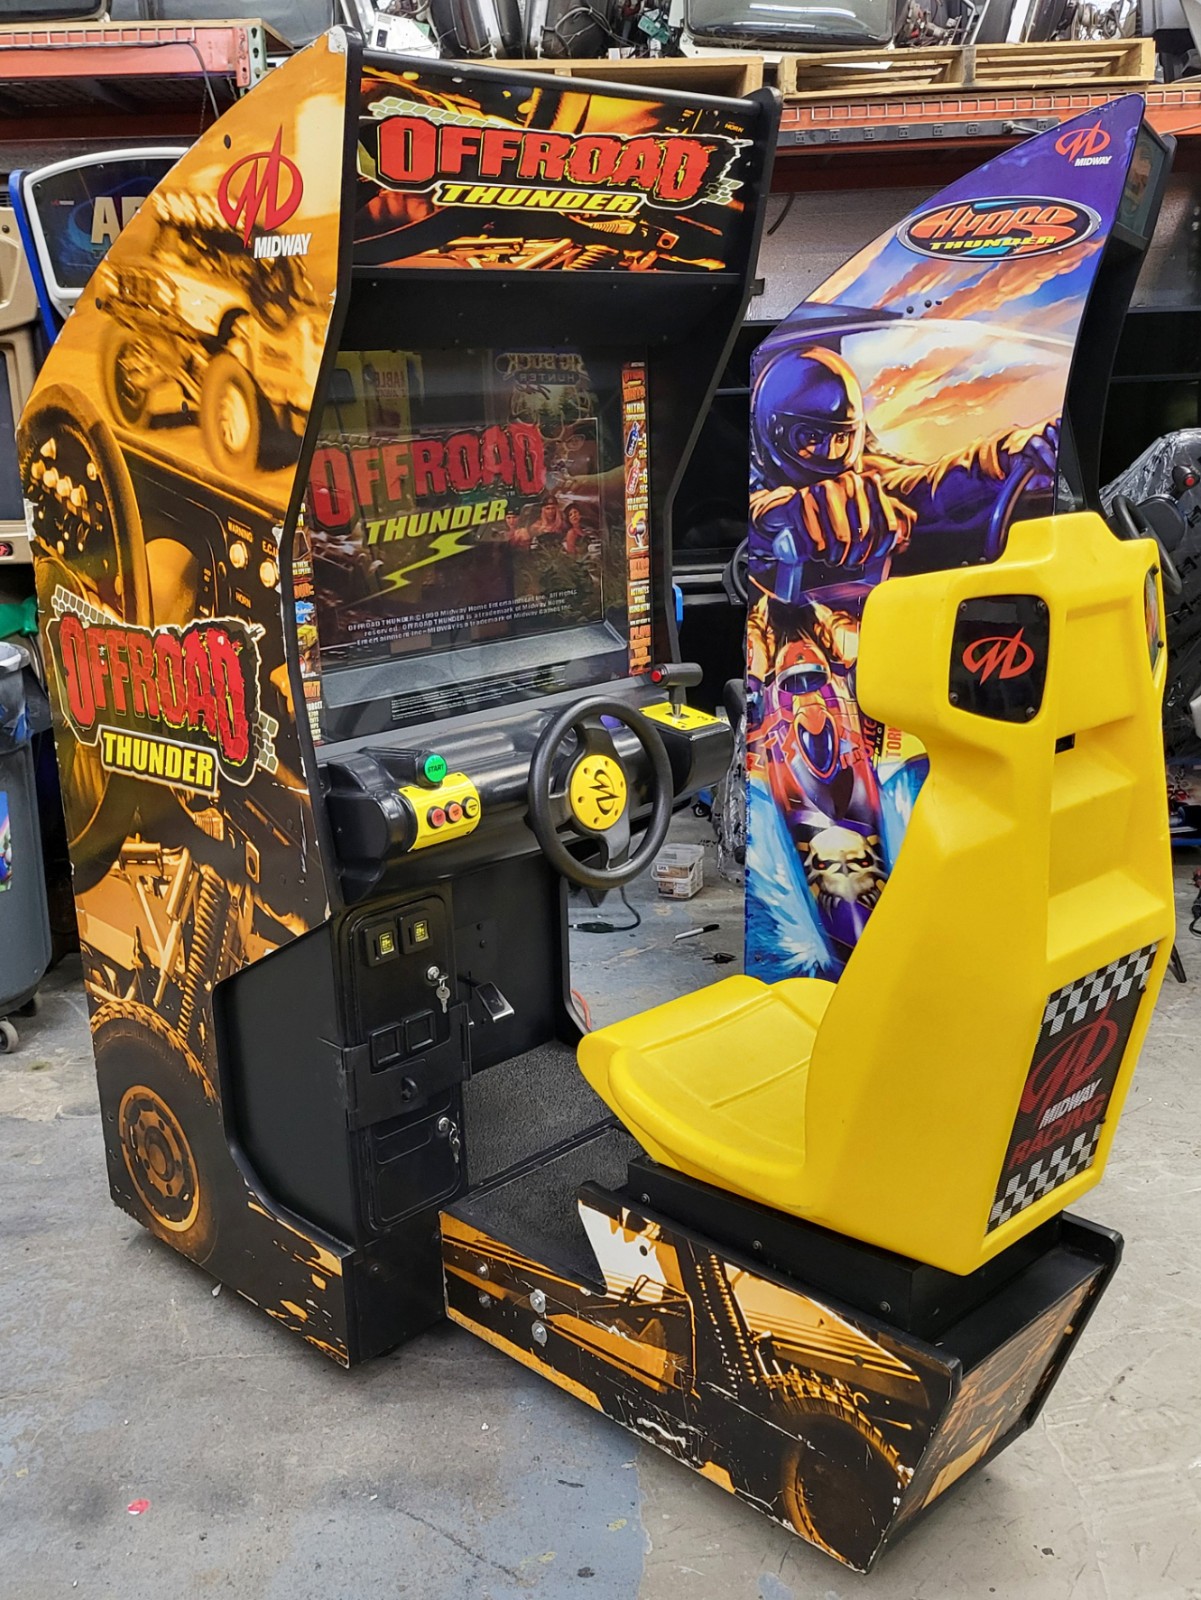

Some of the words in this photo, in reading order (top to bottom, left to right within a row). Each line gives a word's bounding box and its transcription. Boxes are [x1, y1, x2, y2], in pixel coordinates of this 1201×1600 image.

[377, 115, 711, 202] OFFROAD
[1074, 156, 1113, 167] MIDWAY
[442, 184, 638, 213] THUNDER
[253, 233, 312, 259] MIDWAY
[930, 236, 1057, 250] THUNDER
[309, 423, 547, 528] OFFROAD
[227, 520, 254, 544] WARNING
[364, 499, 508, 546] THUNDER
[235, 591, 252, 609] HORN
[60, 615, 250, 765] OFFROAD
[103, 732, 213, 787] THUNDER
[427, 764, 444, 774] START
[1038, 1078, 1103, 1130] MIDWAY
[1008, 1093, 1107, 1171] RACING
